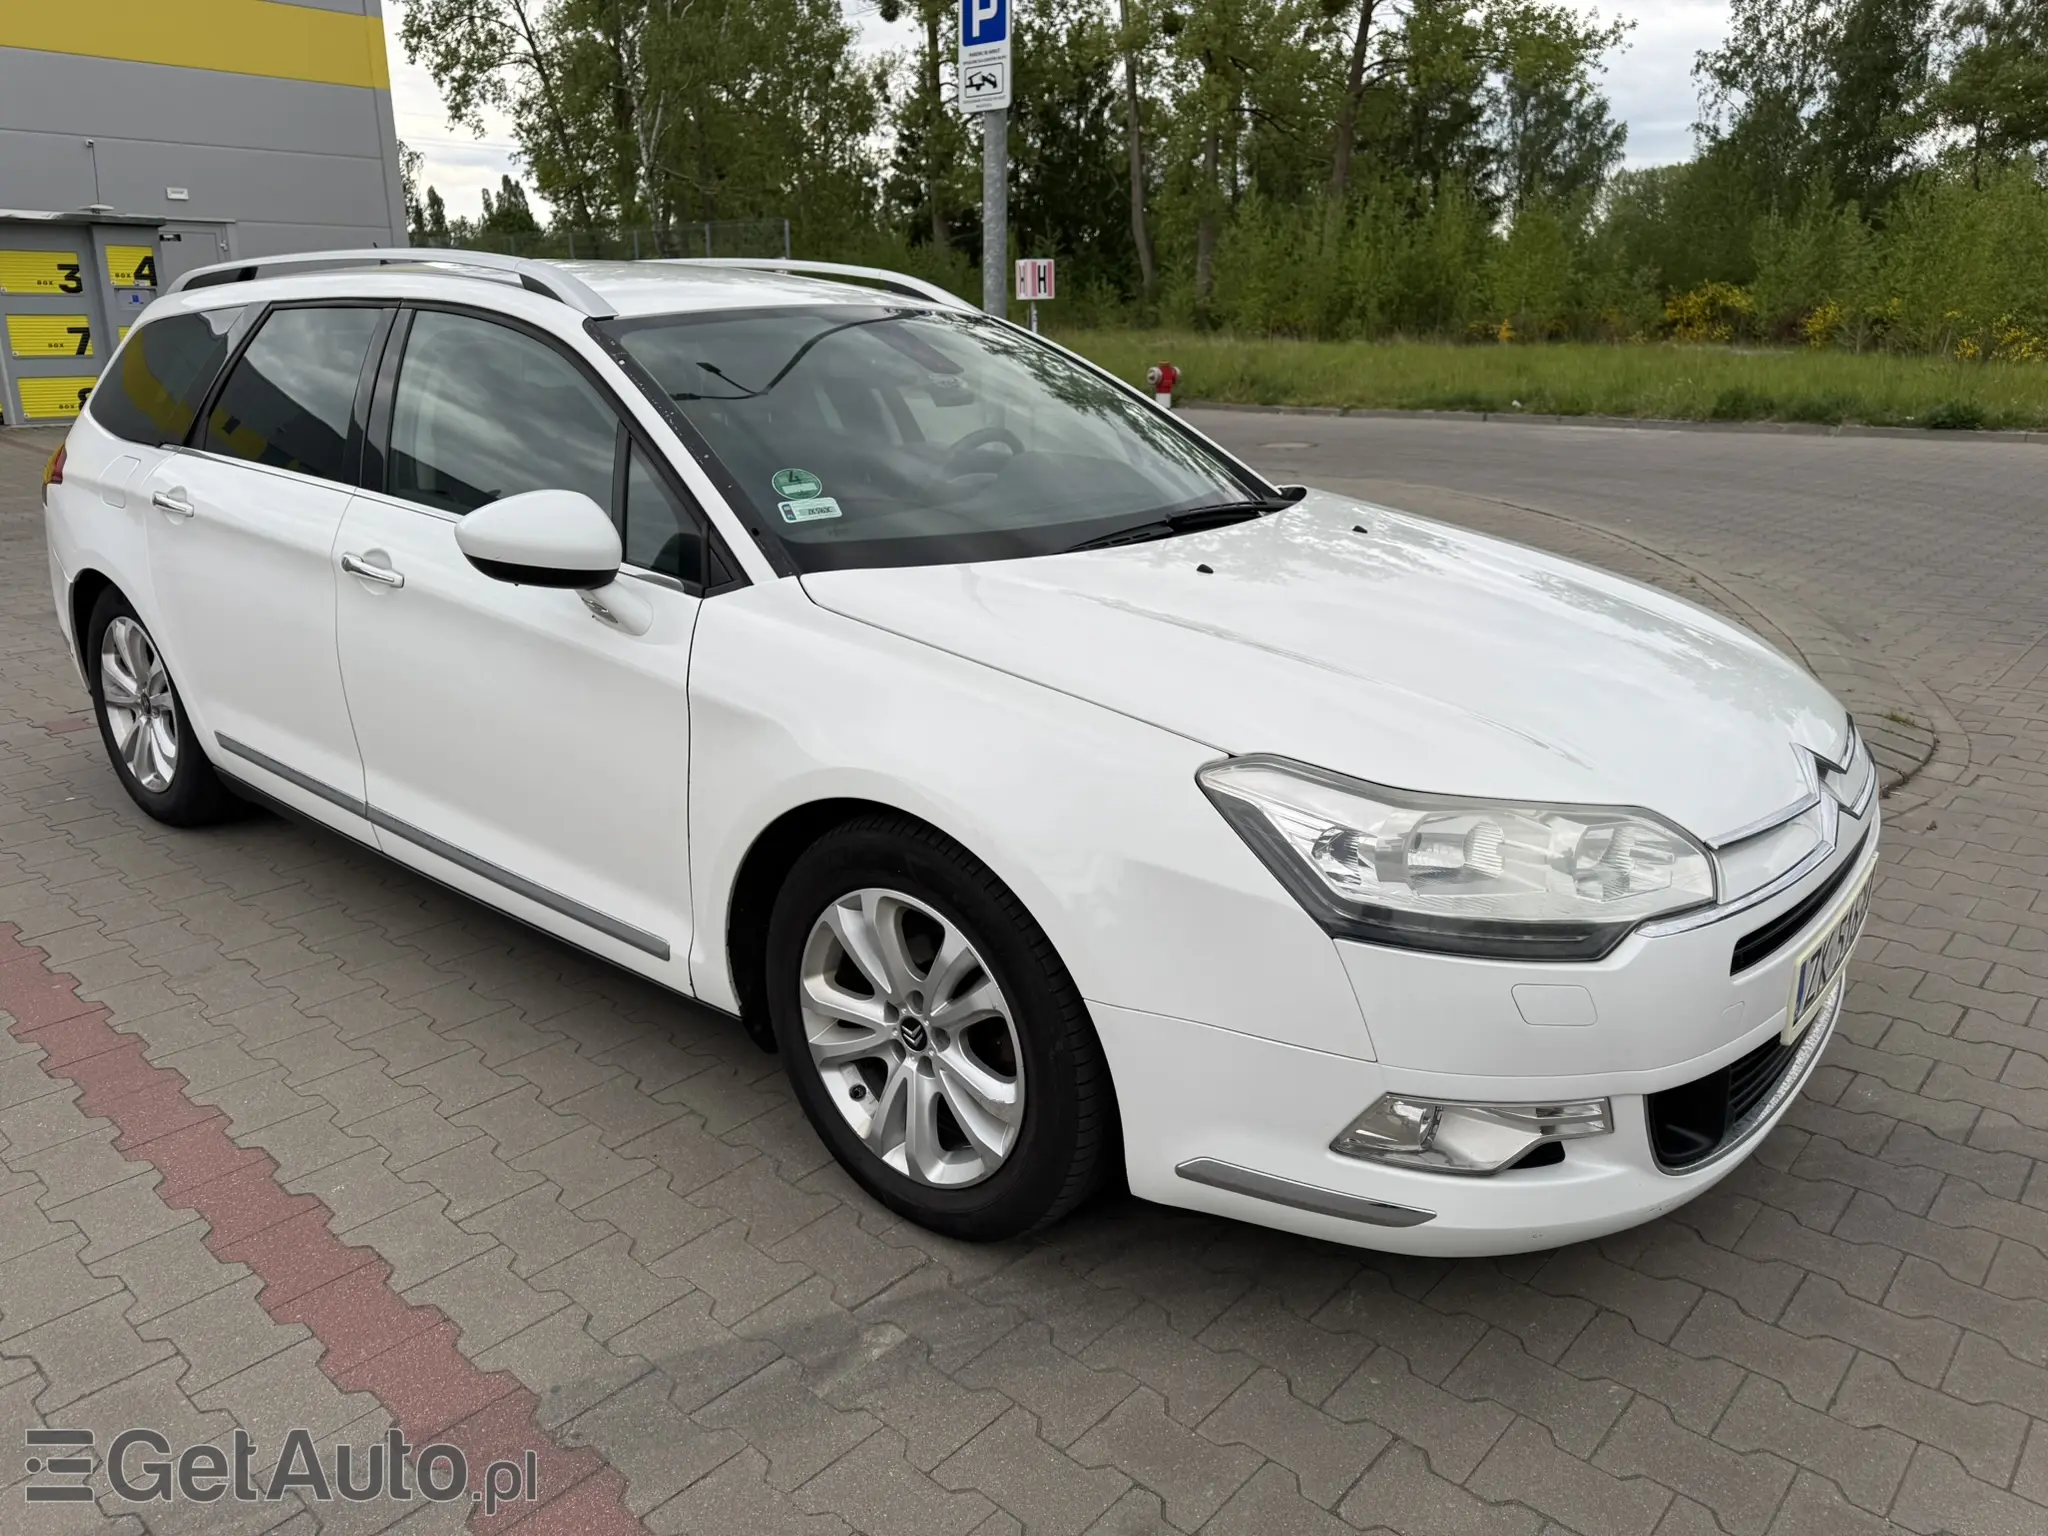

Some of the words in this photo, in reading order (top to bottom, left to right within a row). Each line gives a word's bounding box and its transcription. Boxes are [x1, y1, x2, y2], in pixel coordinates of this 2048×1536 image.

[972, 0, 998, 37] P
[57, 264, 83, 293] 3
[134, 256, 157, 286] 4
[1038, 265, 1047, 293] H
[67, 327, 90, 355] 7
[1803, 928, 1835, 1009] ZK
